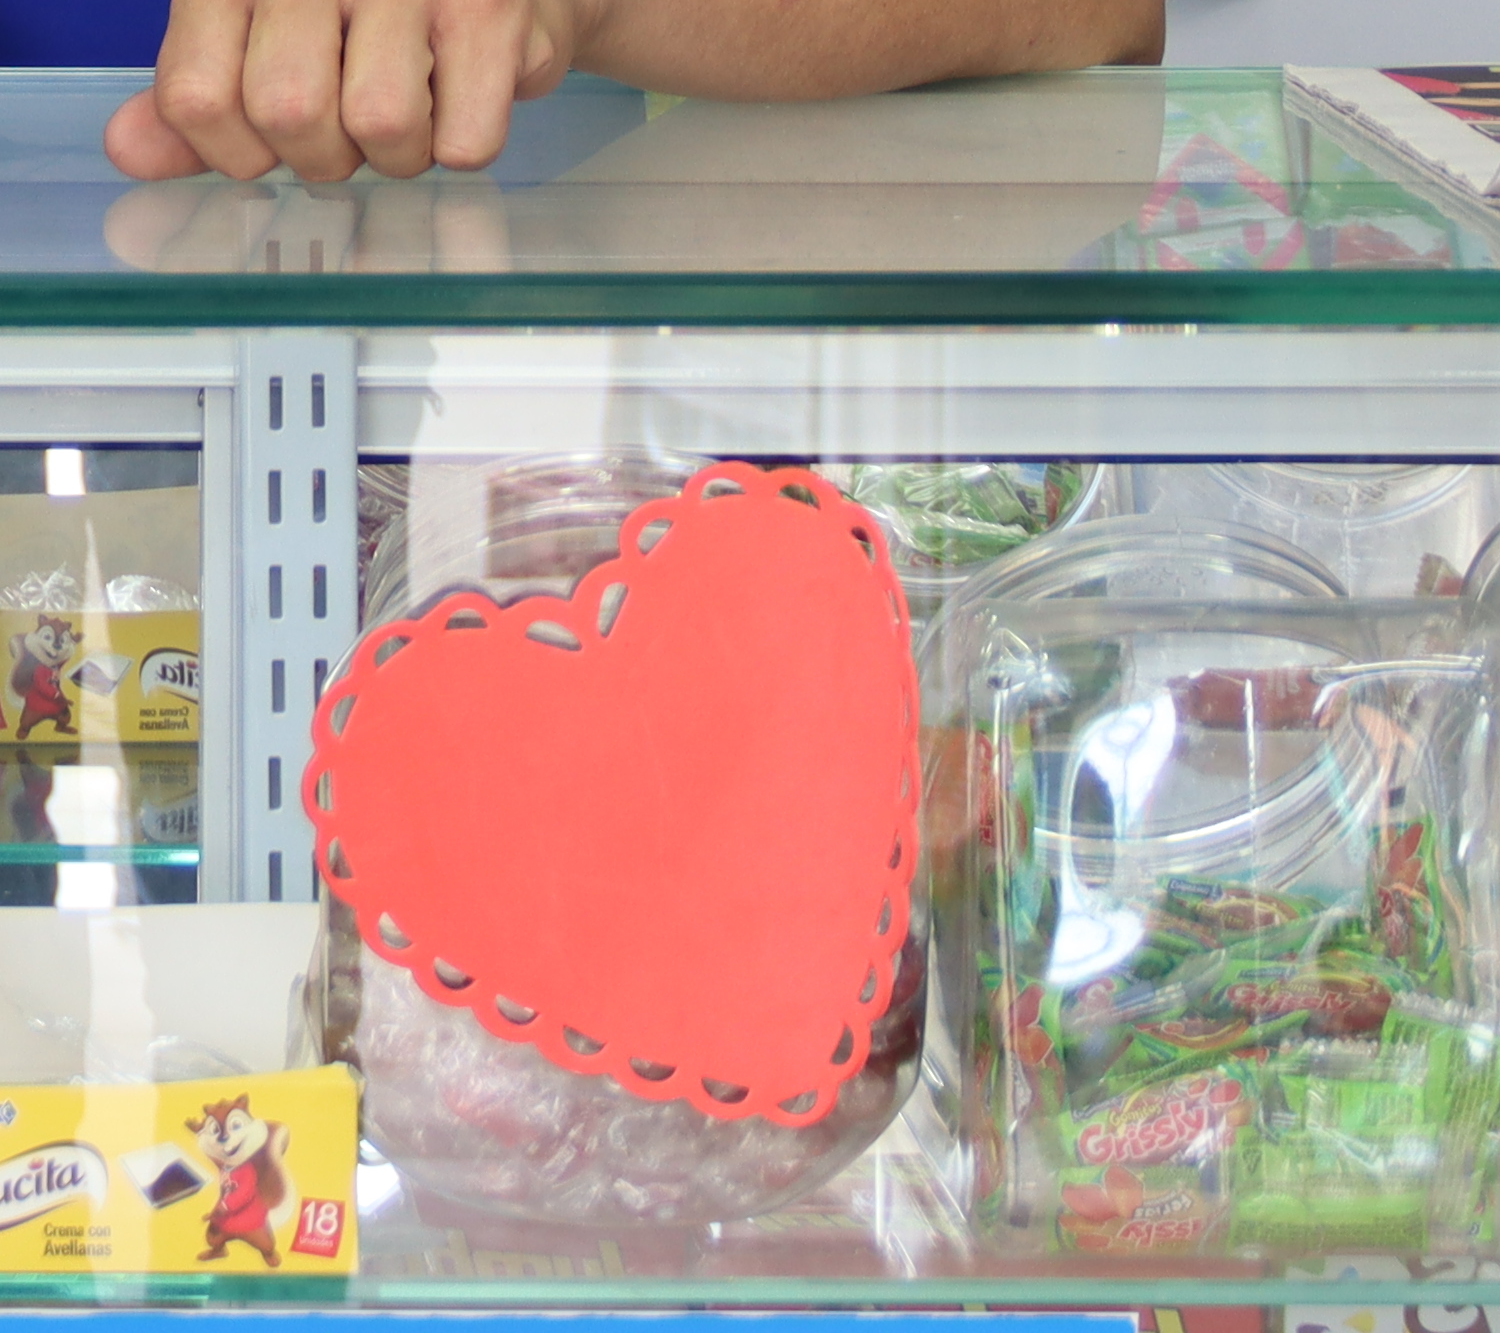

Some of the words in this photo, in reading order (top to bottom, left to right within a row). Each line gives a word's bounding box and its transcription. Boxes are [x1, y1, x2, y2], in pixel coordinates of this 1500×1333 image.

[303, 1202, 338, 1235] 18
[43, 1224, 84, 1238] Crema
[87, 1227, 111, 1238] con
[43, 1241, 113, 1256] Avellanas
